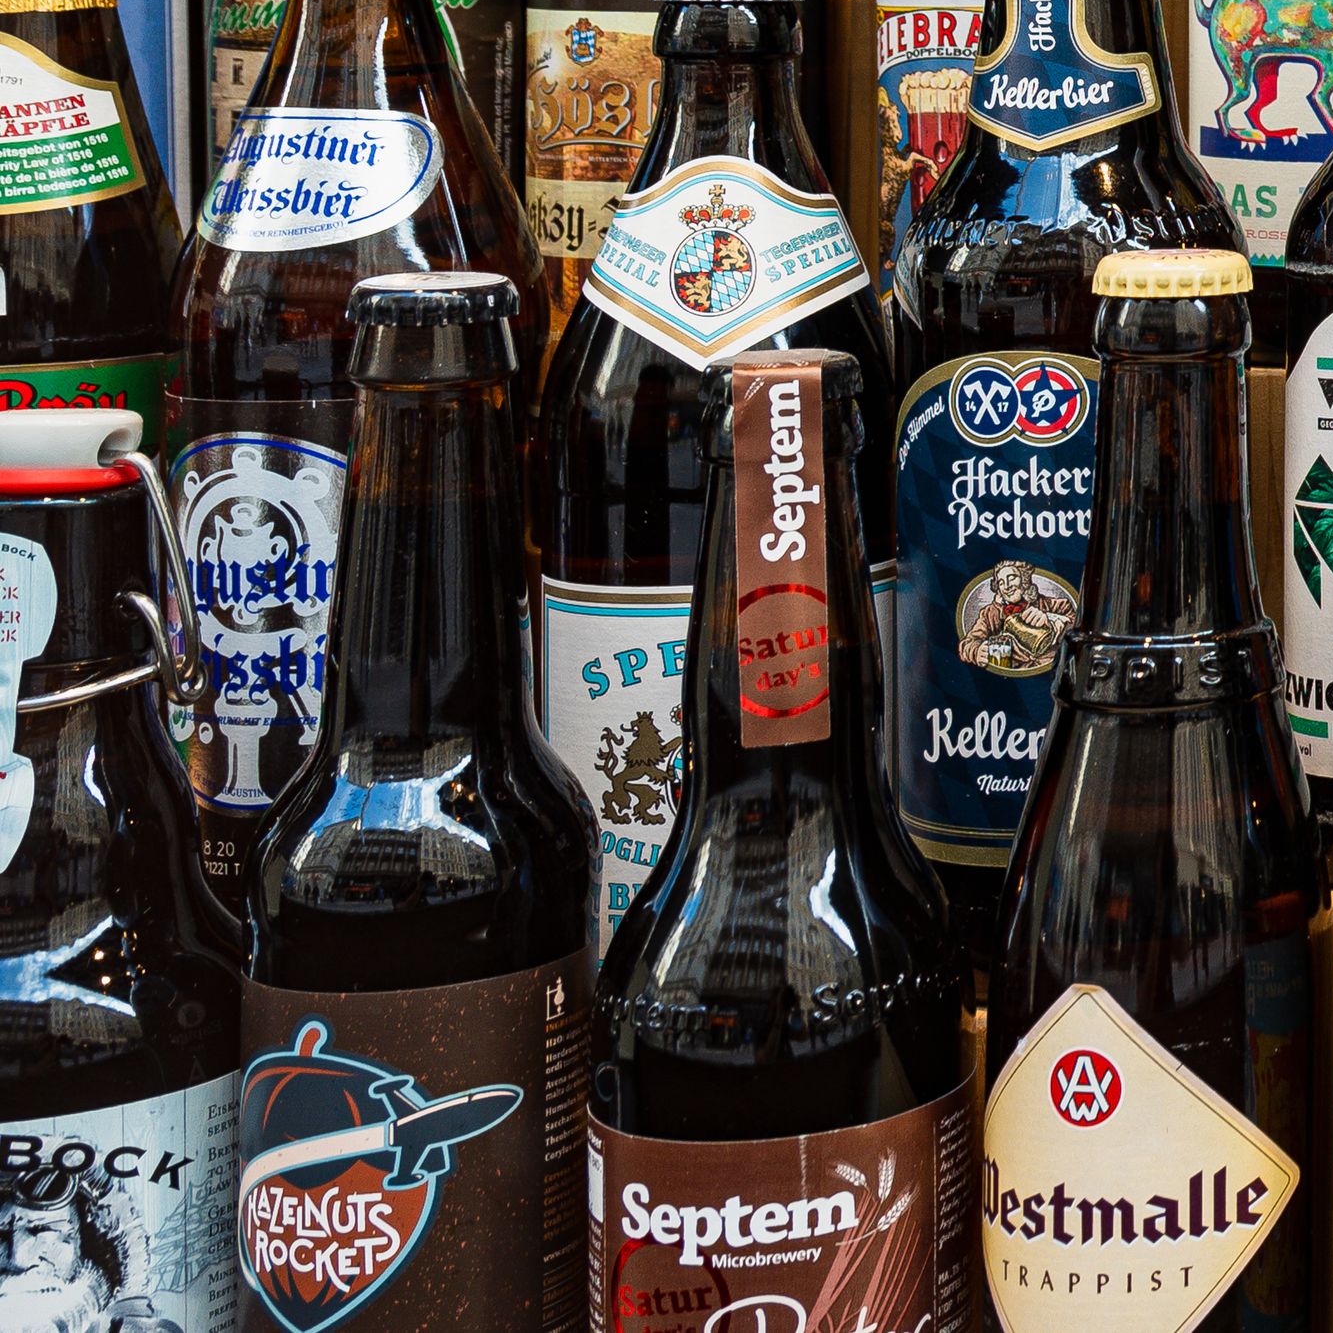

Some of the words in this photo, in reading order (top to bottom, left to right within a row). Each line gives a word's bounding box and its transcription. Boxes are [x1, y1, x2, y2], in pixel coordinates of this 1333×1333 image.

[984, 74, 1114, 111] Kellerbier
[23, 155, 47, 169] Law
[48, 153, 62, 165] of
[66, 149, 94, 163] 1516
[56, 138, 79, 150] von
[81, 132, 109, 146] 1516
[225, 125, 385, 171] Augustiner
[15, 172, 32, 185] de
[34, 170, 44, 182] la
[79, 162, 95, 175] de
[97, 154, 120, 169] 1516
[39, 177, 87, 194] tedesco
[88, 171, 105, 184] del
[106, 164, 130, 180] 1516
[210, 179, 367, 221] Weissbier
[759, 222, 842, 261] TEGERNSEER
[765, 238, 853, 284] SPEZIAL
[965, 400, 976, 412] 14
[997, 400, 1009, 413] 17
[759, 379, 822, 563] Septem
[951, 456, 1092, 504] Hacker
[947, 497, 1092, 549] Pschorr
[755, 660, 823, 693] day's
[2, 1134, 196, 1191] BOCK
[984, 1159, 1269, 1246] Westmalle
[248, 1185, 400, 1261] HAZELNUTS
[622, 1183, 860, 1266] Septem
[712, 1246, 822, 1269] Microbrewery
[1002, 1259, 1195, 1294] TRAPPIST
[619, 1285, 713, 1318] Satur
